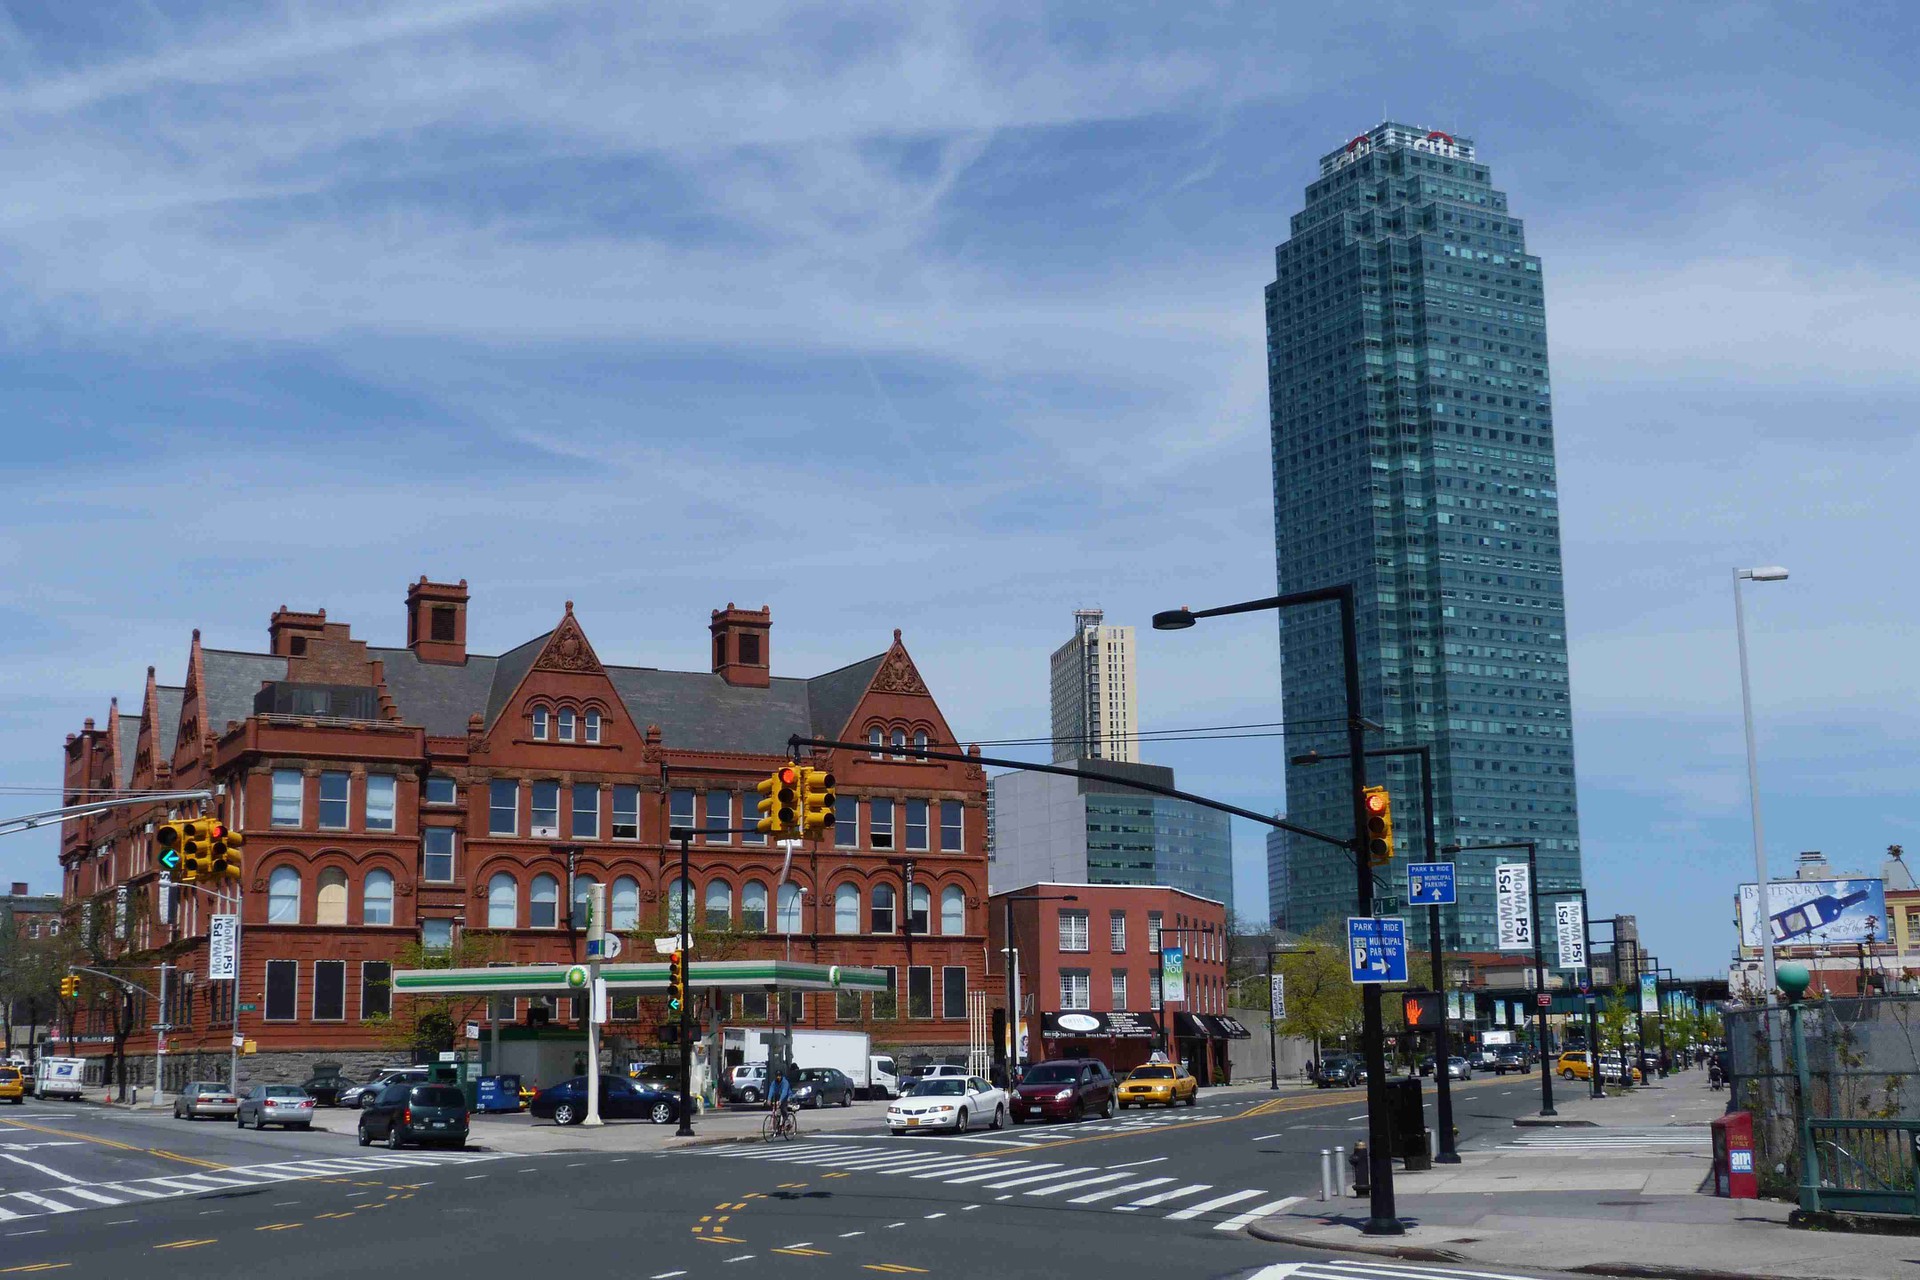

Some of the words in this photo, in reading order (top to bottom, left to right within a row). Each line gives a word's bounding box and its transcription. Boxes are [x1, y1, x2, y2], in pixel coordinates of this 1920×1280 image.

[1414, 133, 1454, 158] citi
[1498, 869, 1511, 894] PS1
[1514, 868, 1528, 915] MoMA
[1375, 901, 1384, 914] 21
[1558, 906, 1568, 924] PS1
[214, 918, 222, 936] PS1
[1354, 923, 1372, 931] PARK
[1384, 924, 1399, 932] RIDE
[1500, 896, 1514, 943] MoMA
[1516, 918, 1528, 943] PS1
[1570, 906, 1582, 940] MoMA
[224, 918, 234, 952] MoMA
[1560, 927, 1570, 962] MoMA
[212, 940, 222, 974] MoMA
[1164, 954, 1182, 964] LIC
[1354, 948, 1367, 969] P
[1572, 944, 1582, 962] PS1
[223, 956, 232, 974] PS1
[1732, 1152, 1752, 1165] am
